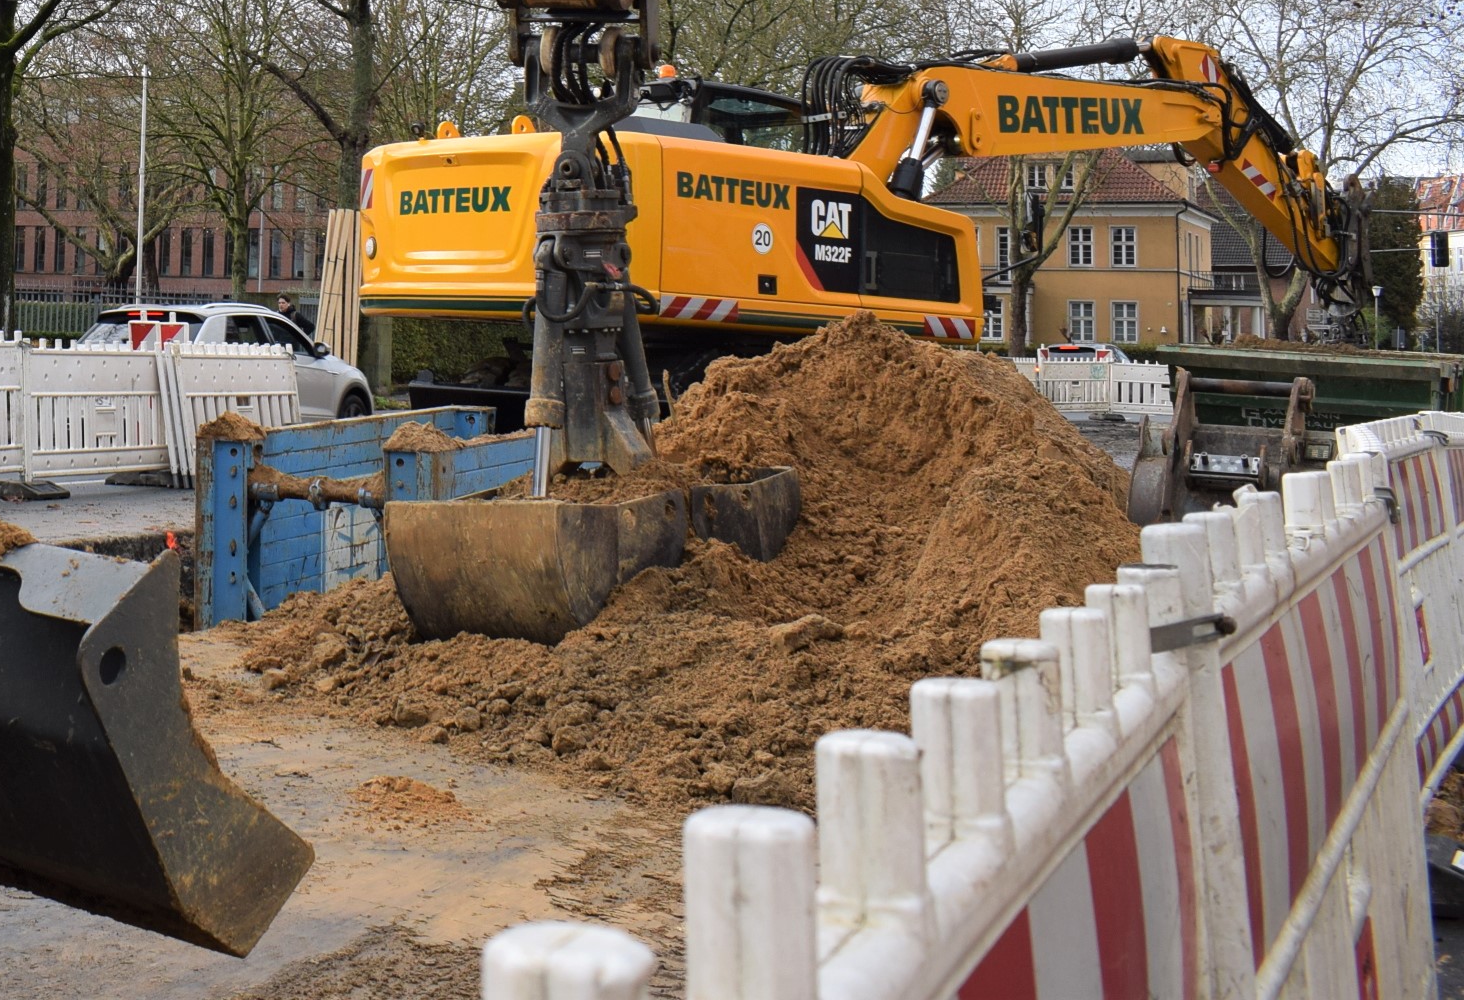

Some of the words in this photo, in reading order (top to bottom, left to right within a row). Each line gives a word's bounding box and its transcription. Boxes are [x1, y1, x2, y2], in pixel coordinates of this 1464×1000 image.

[997, 95, 1145, 135] BATTEUX
[399, 186, 512, 216] BATTEUX
[676, 171, 790, 210] BATTEUX
[811, 199, 852, 239] CAT
[754, 229, 771, 247] 20
[814, 244, 852, 264] M322F
